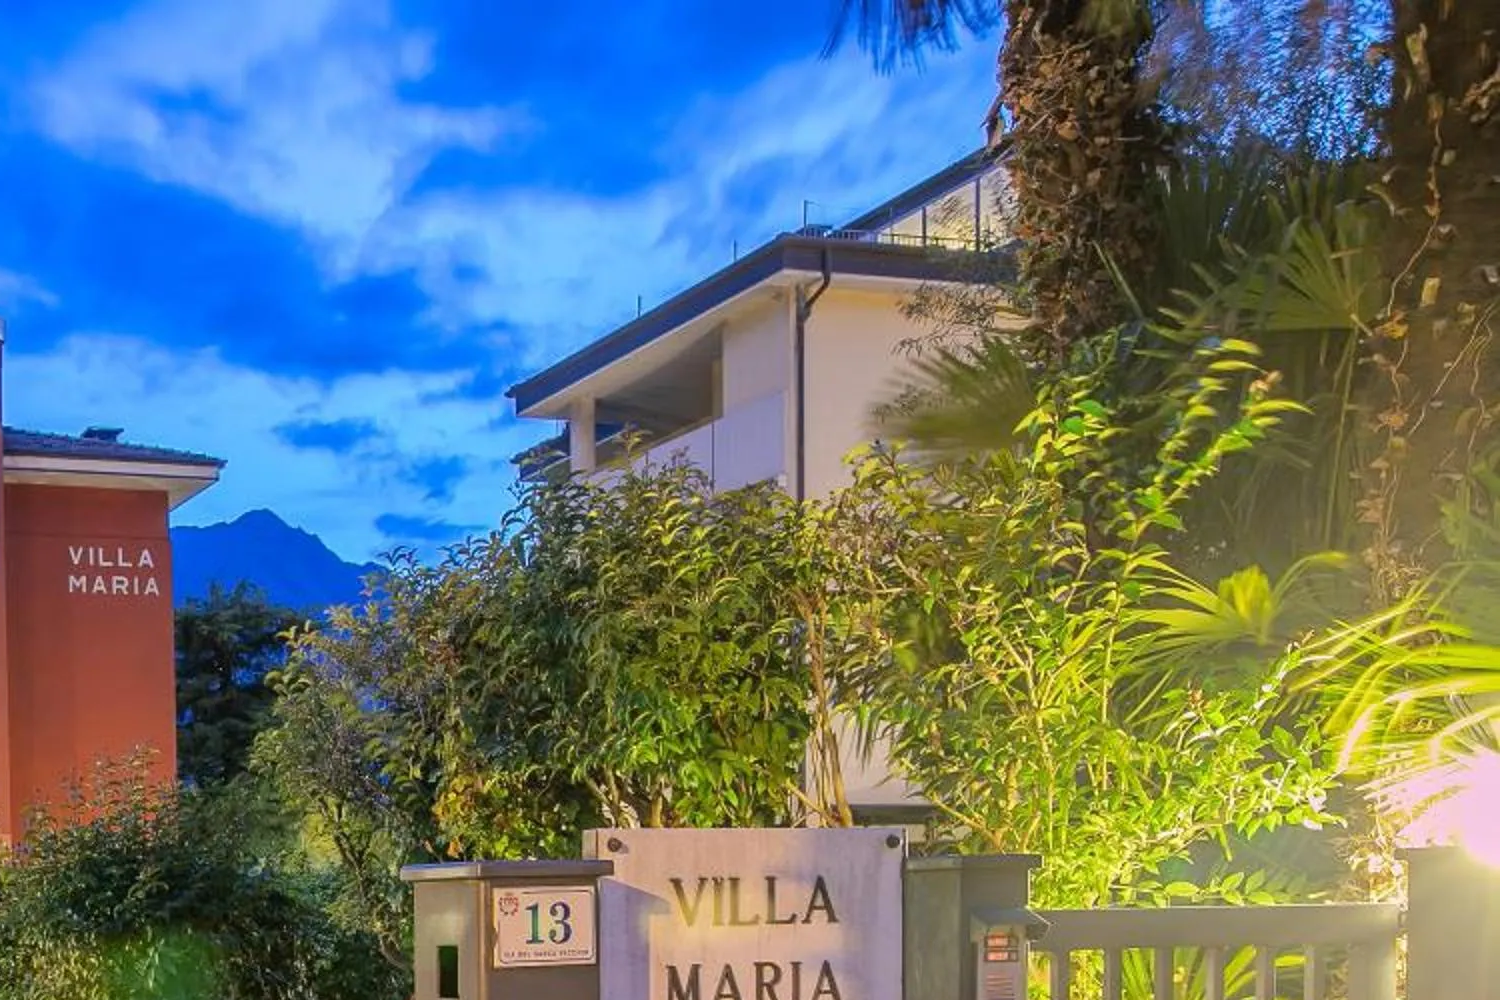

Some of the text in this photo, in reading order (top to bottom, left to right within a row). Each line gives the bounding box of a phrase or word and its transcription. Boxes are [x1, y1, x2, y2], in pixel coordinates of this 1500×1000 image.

[68, 545, 154, 568] VILLA
[68, 575, 160, 596] MARIA
[669, 874, 840, 928] VILLA
[525, 901, 572, 945] 13
